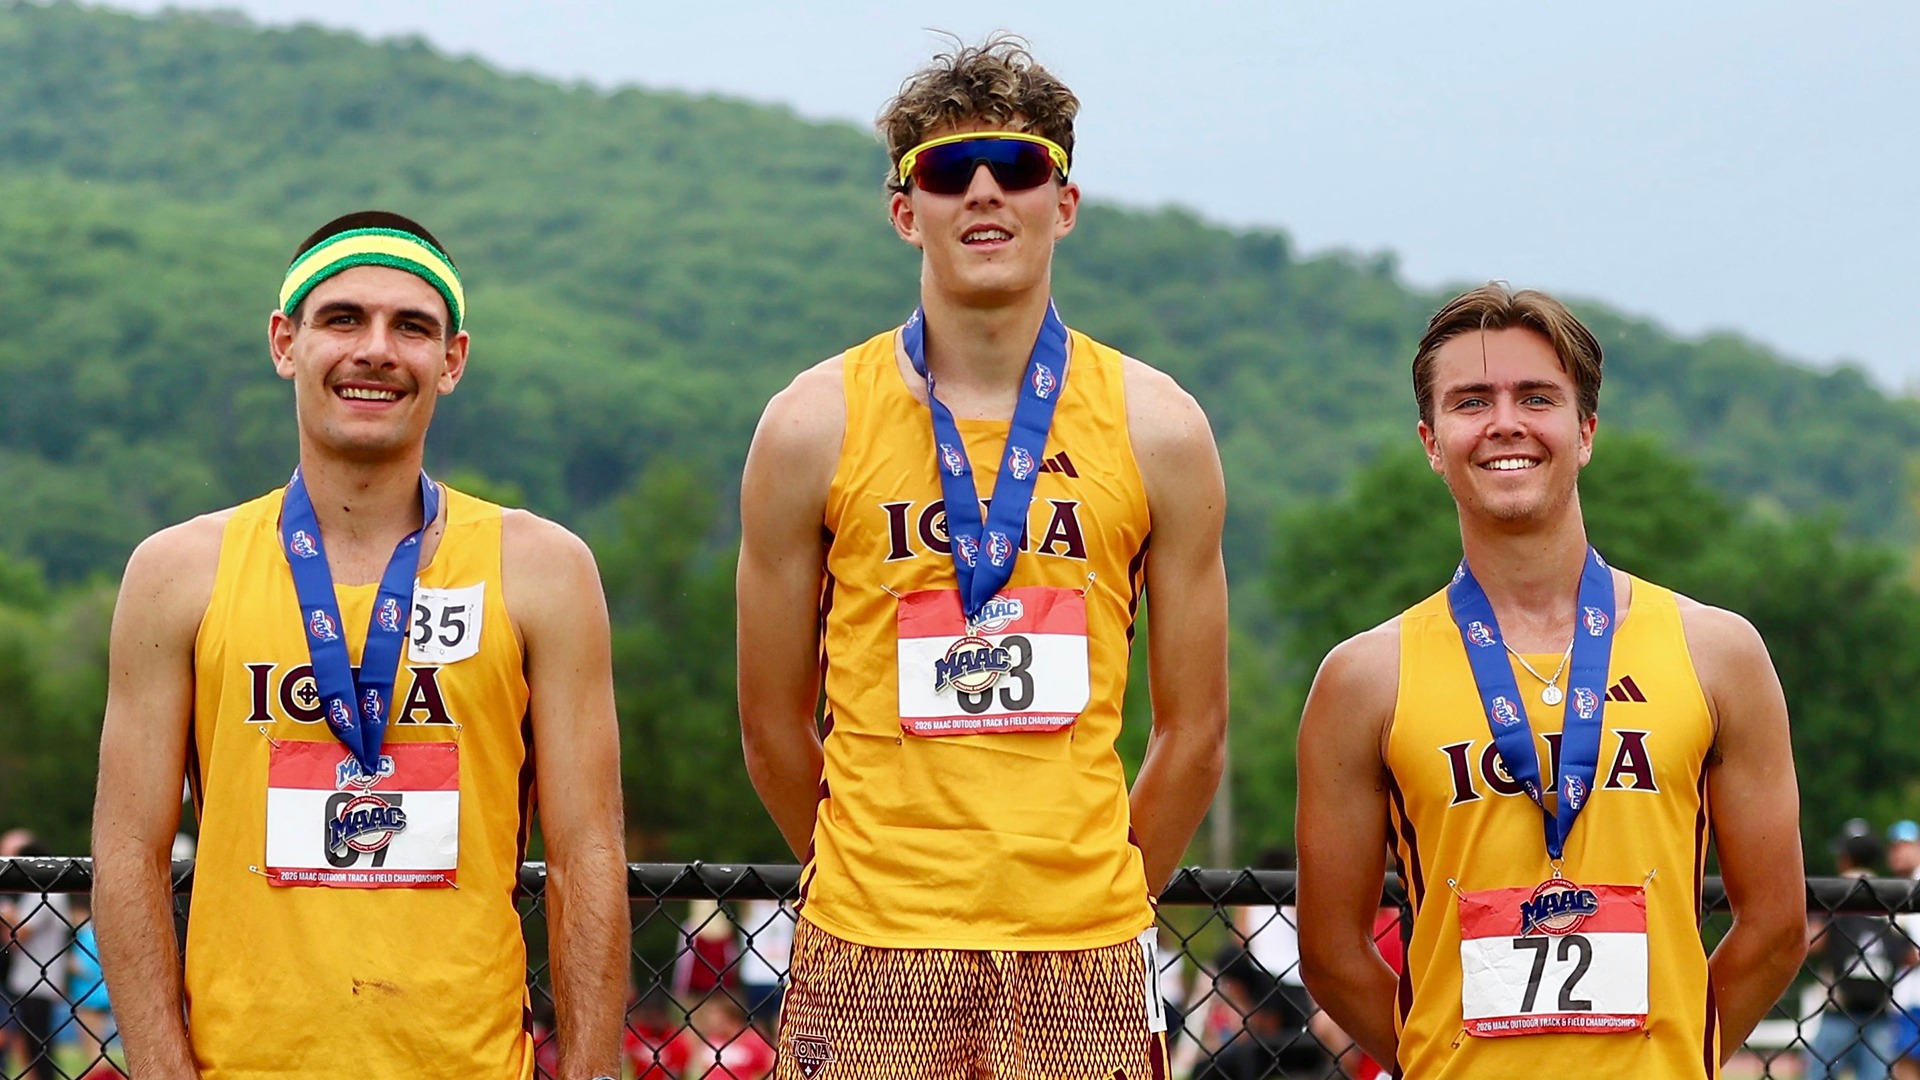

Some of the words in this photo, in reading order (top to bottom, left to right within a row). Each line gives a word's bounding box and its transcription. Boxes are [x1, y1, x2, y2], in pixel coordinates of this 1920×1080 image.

[879, 498, 1088, 563] IOA
[934, 647, 1012, 692] MAAC
[243, 663, 456, 726] IOA
[915, 721, 932, 730] 2026
[933, 720, 951, 729] MAAC
[952, 719, 981, 729] OUTDOOR
[982, 718, 1003, 728] TRACK
[1009, 717, 1027, 726] FIELD
[328, 806, 407, 852] MAAC
[280, 871, 298, 881] 2026
[299, 872, 317, 881] MAAC
[318, 873, 346, 882] OUTDOOR
[347, 873, 368, 882] TRACK
[375, 874, 392, 883] FIELD
[393, 874, 445, 883] CHAMPIONSHIPS
[1520, 889, 1598, 936] MAAC
[1513, 935, 1593, 1012] 72
[1476, 1021, 1492, 1032] 2026
[1492, 1020, 1510, 1030] MAAC
[1510, 1019, 1538, 1029] OUTDOOR
[1540, 1018, 1560, 1028] TRACK
[1567, 1017, 1584, 1026] FIELD
[1586, 1017, 1636, 1027] CHAMPIONSHIPS
[791, 1040, 831, 1061] IONA
